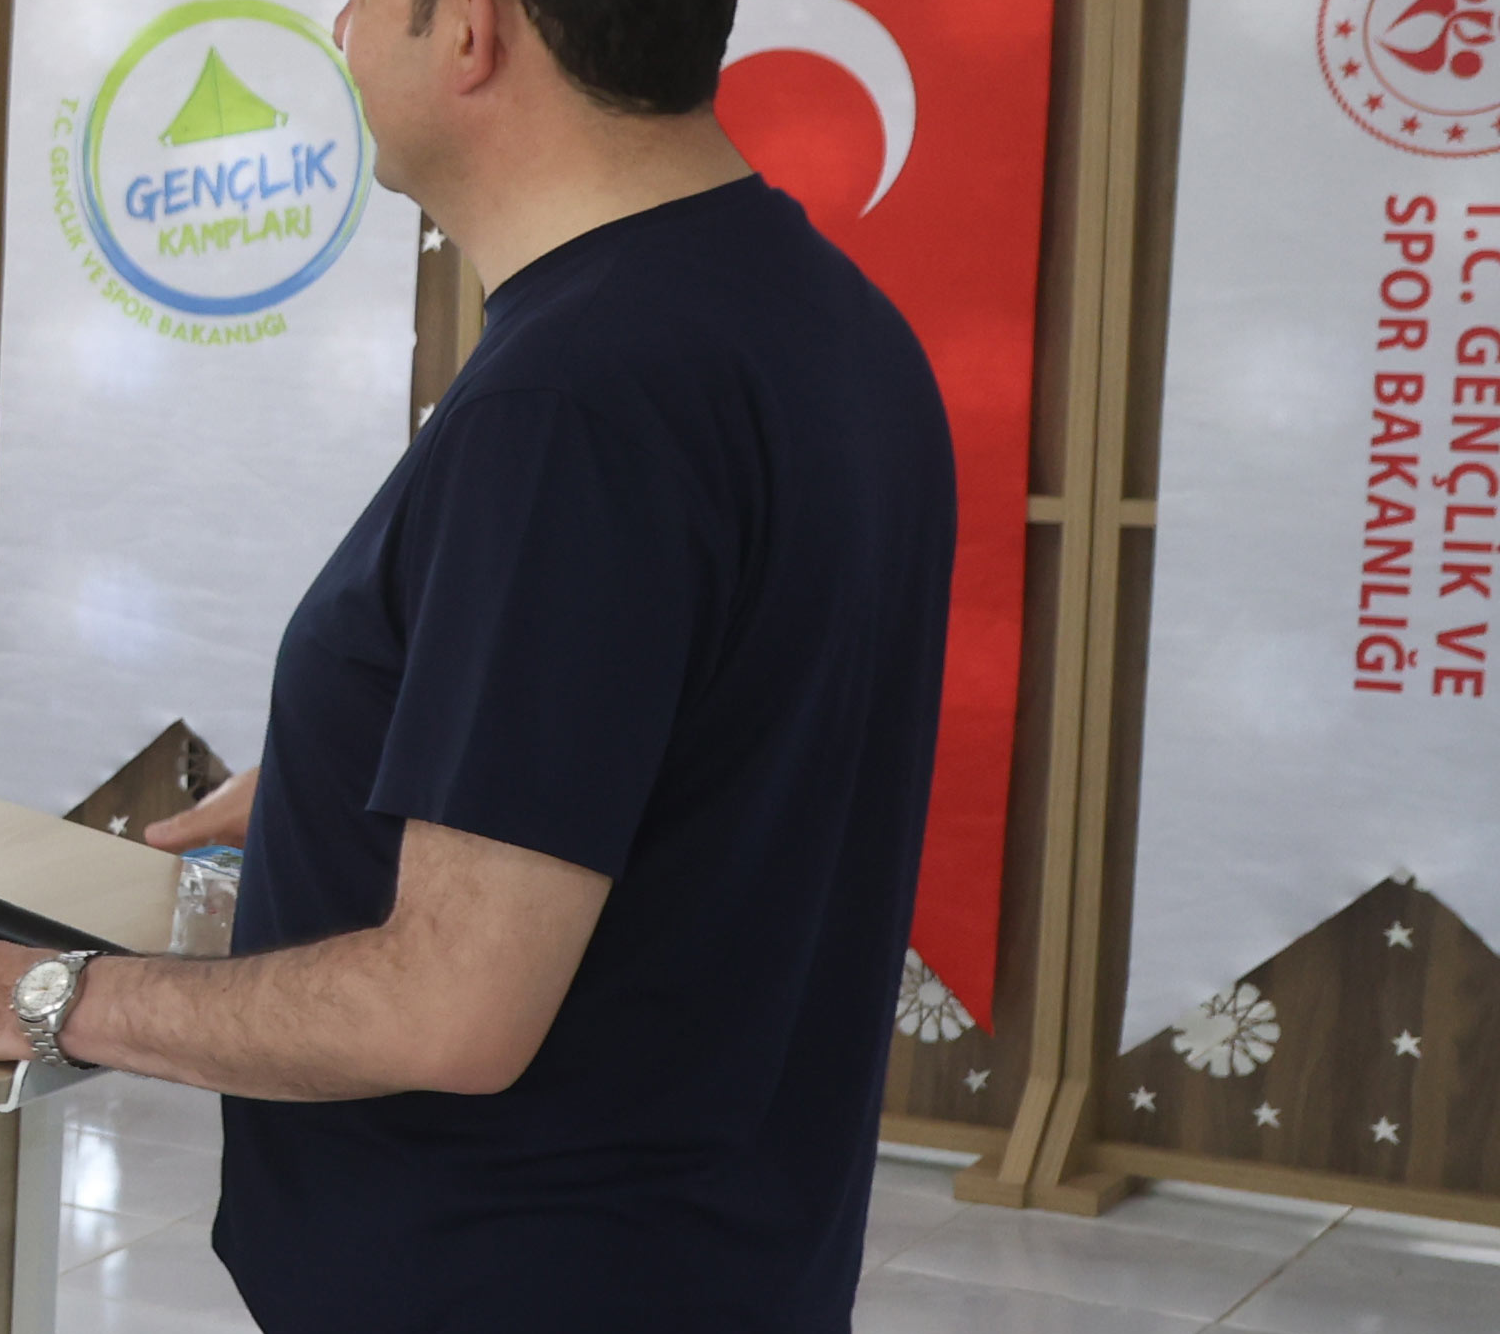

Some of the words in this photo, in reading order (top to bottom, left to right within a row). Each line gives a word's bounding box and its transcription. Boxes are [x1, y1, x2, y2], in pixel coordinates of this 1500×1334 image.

[126, 140, 338, 221] GENÇLİK
[158, 204, 312, 256] KAMPLARI
[101, 278, 153, 327] SPOR
[1376, 194, 1437, 351] SPOR
[1432, 326, 1500, 599] GENÇLİK
[1354, 372, 1425, 693] BAKANLIĞI
[1432, 622, 1489, 698] VE
